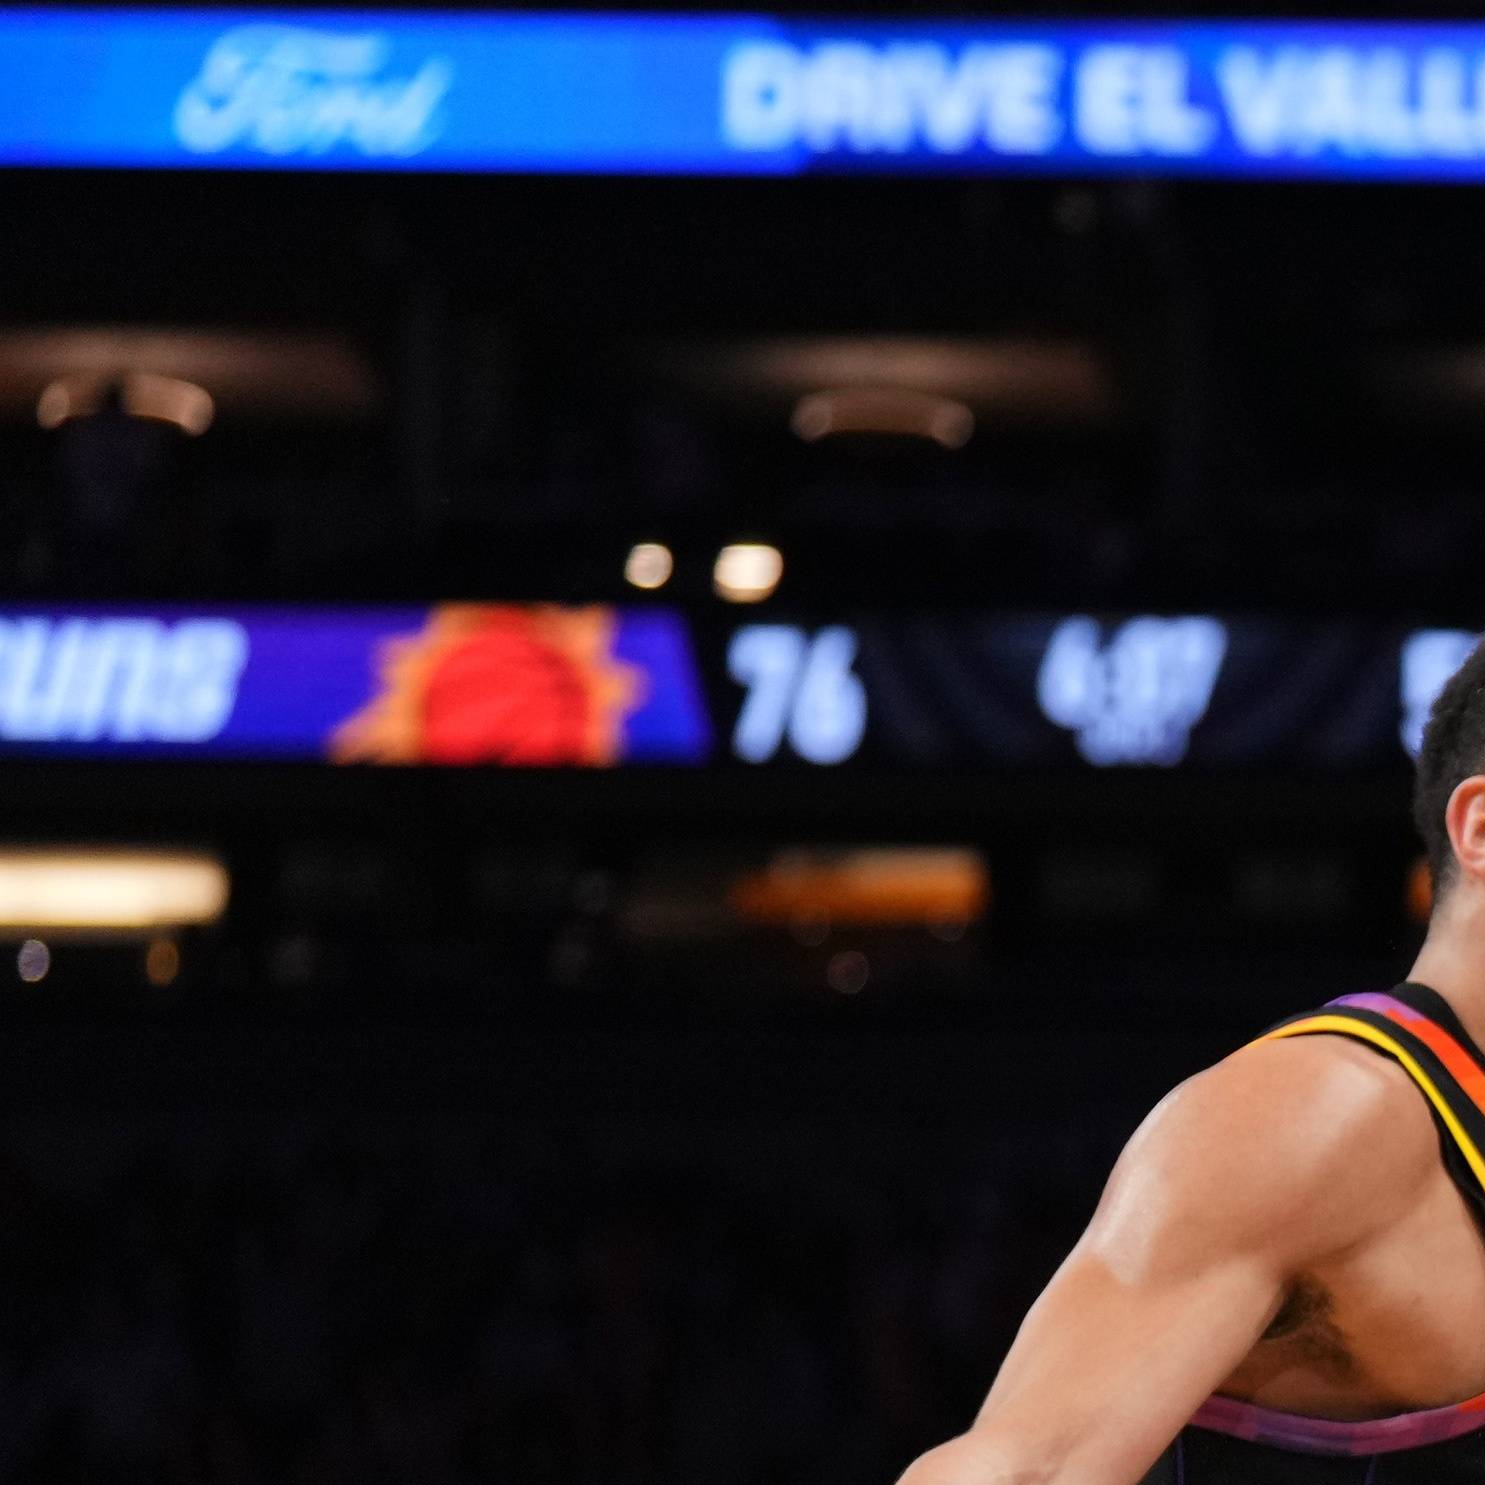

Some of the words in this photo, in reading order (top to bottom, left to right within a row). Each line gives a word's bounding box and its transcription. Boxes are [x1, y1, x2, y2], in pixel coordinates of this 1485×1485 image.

[720, 42, 1057, 155] DRIVE
[1074, 44, 1212, 156] EL
[727, 624, 867, 764] 76
